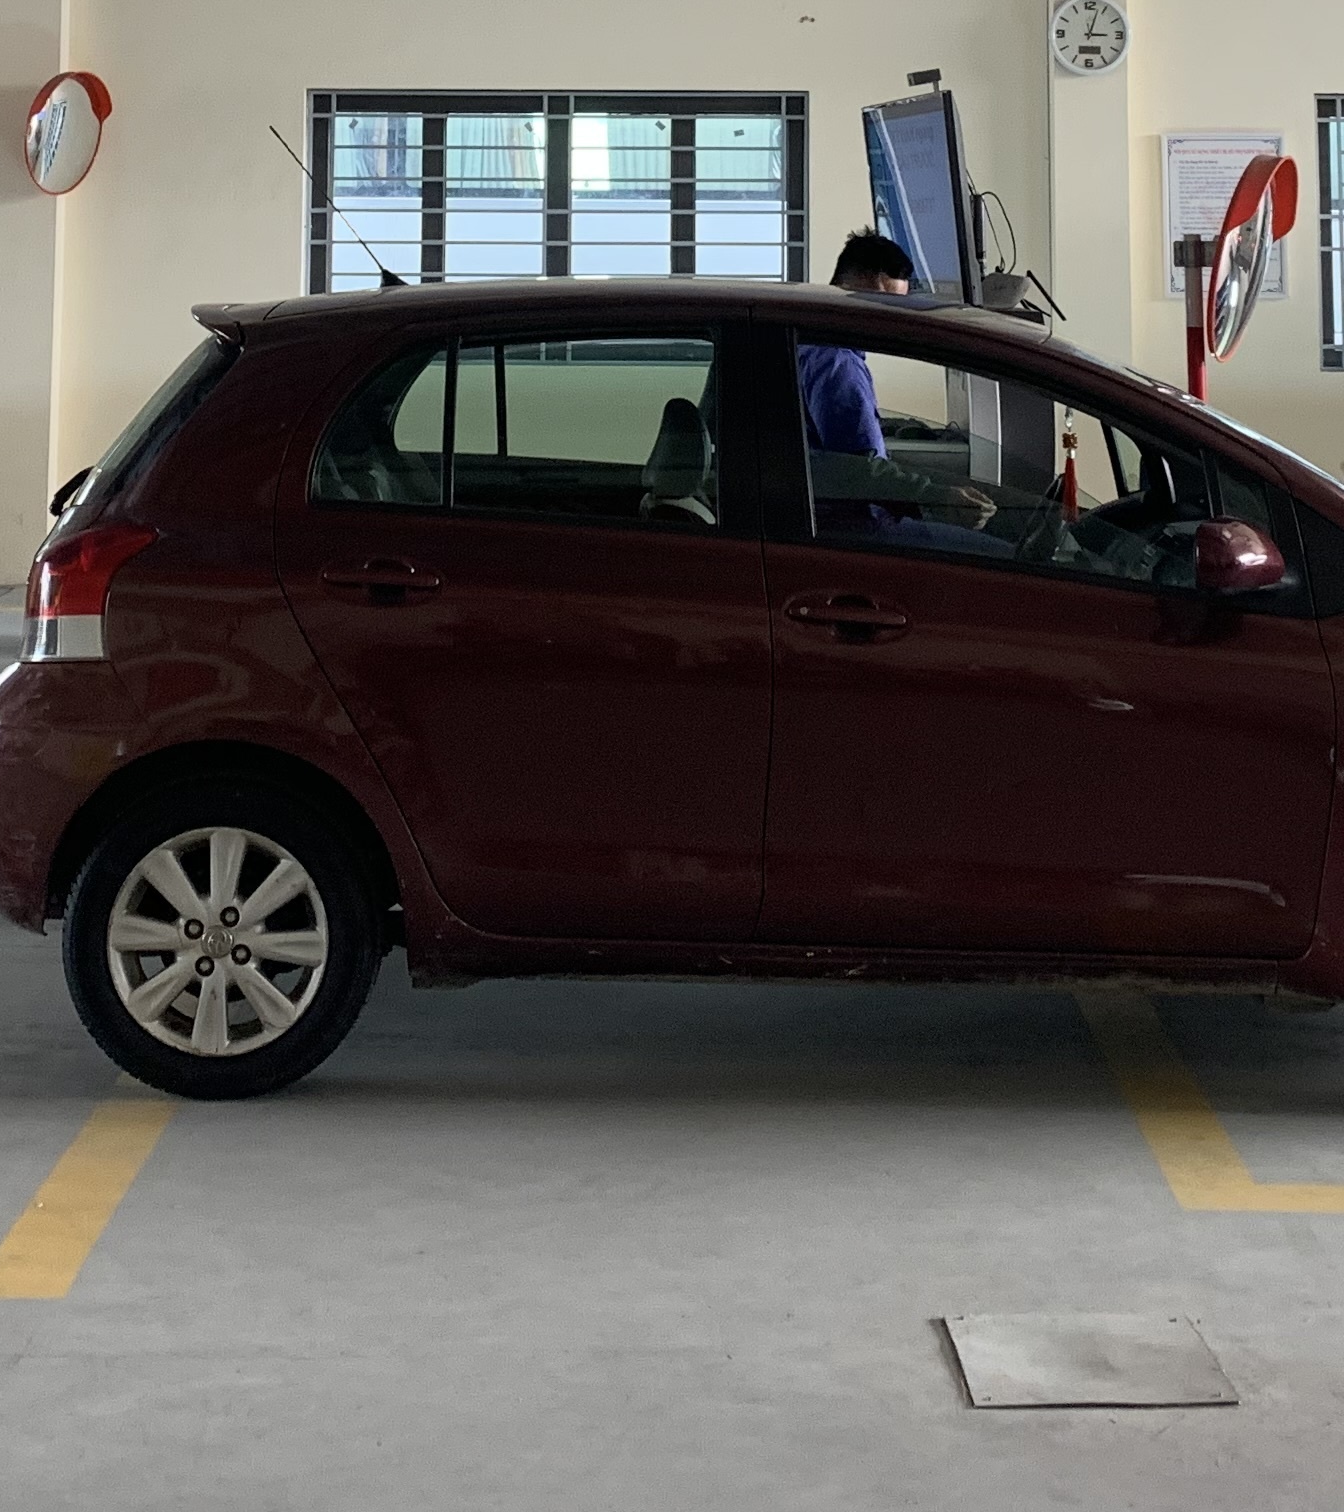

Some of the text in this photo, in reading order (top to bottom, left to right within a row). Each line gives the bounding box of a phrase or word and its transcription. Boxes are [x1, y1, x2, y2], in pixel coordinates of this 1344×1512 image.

[1084, 1, 1097, 10] 12
[1056, 29, 1065, 39] 9
[1115, 31, 1124, 40] 3
[1085, 59, 1094, 68] 6
